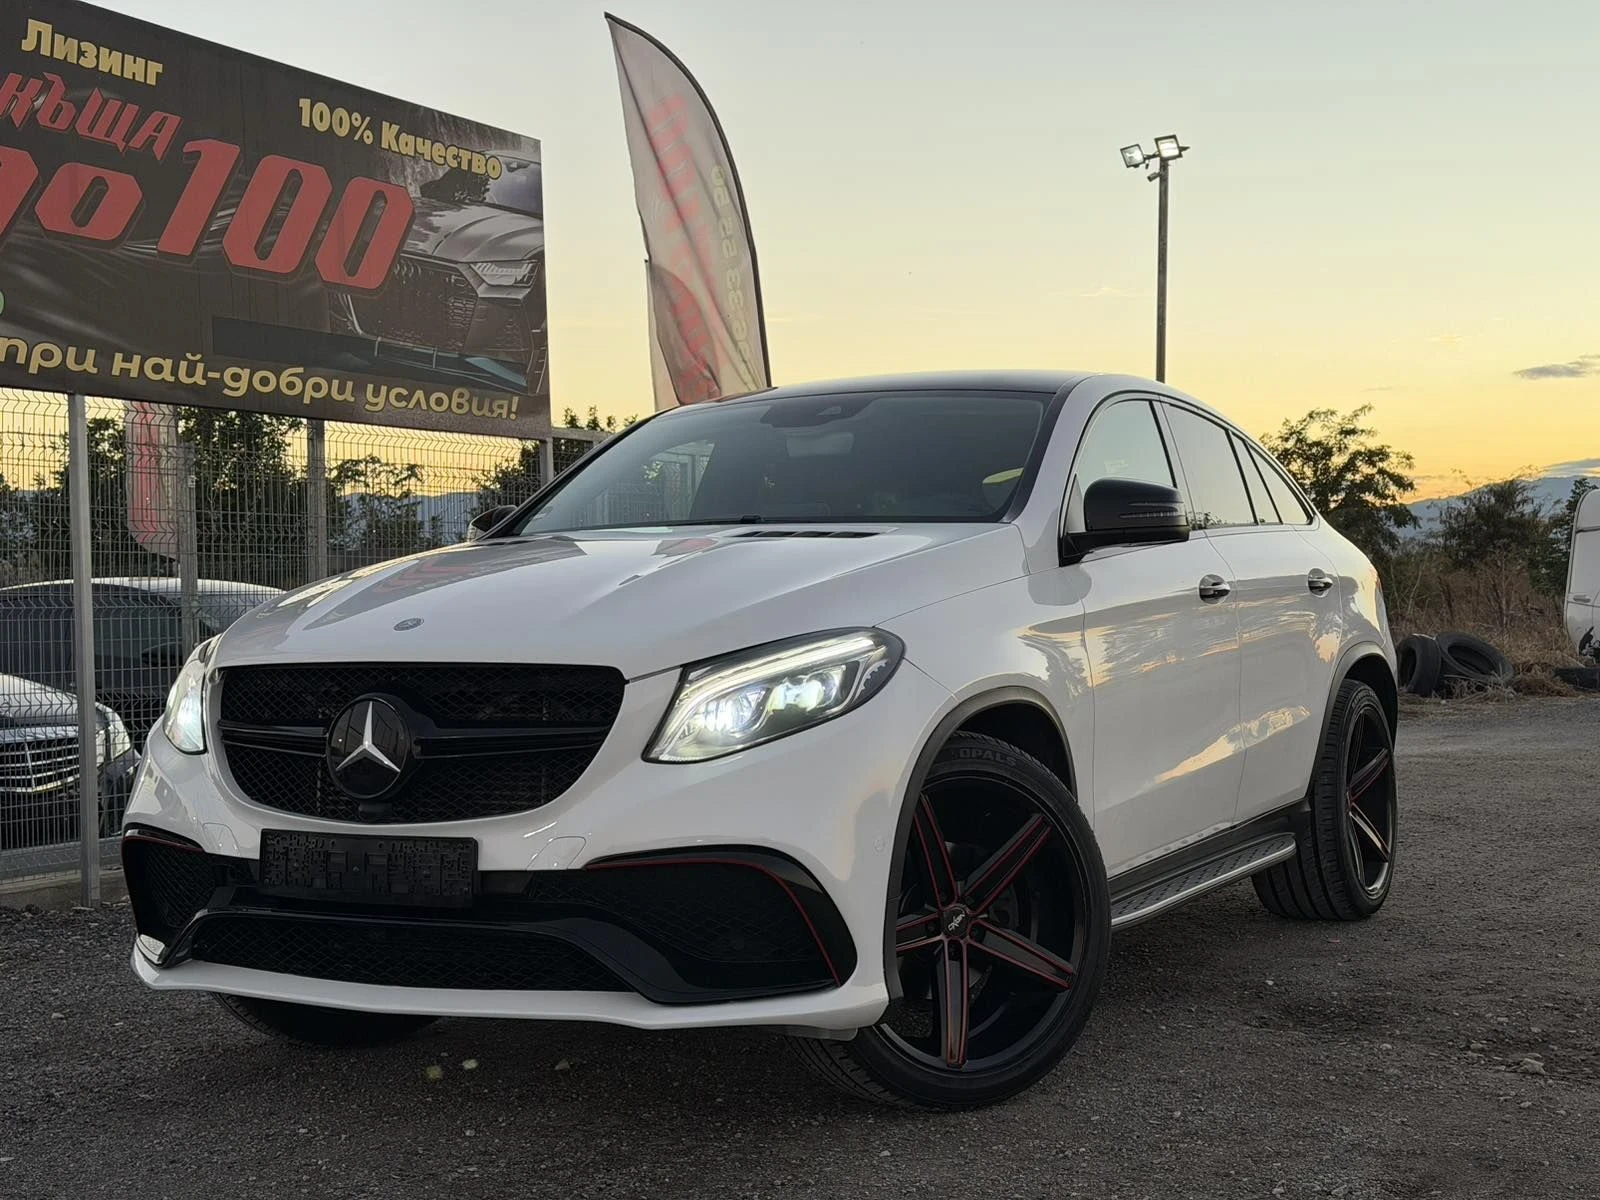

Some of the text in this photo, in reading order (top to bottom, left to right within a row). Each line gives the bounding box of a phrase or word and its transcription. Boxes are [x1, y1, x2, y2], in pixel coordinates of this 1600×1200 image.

[22, 19, 163, 86] Лизинг
[299, 98, 502, 179] 100% Качество
[0, 337, 519, 421] при най-добри условия!
